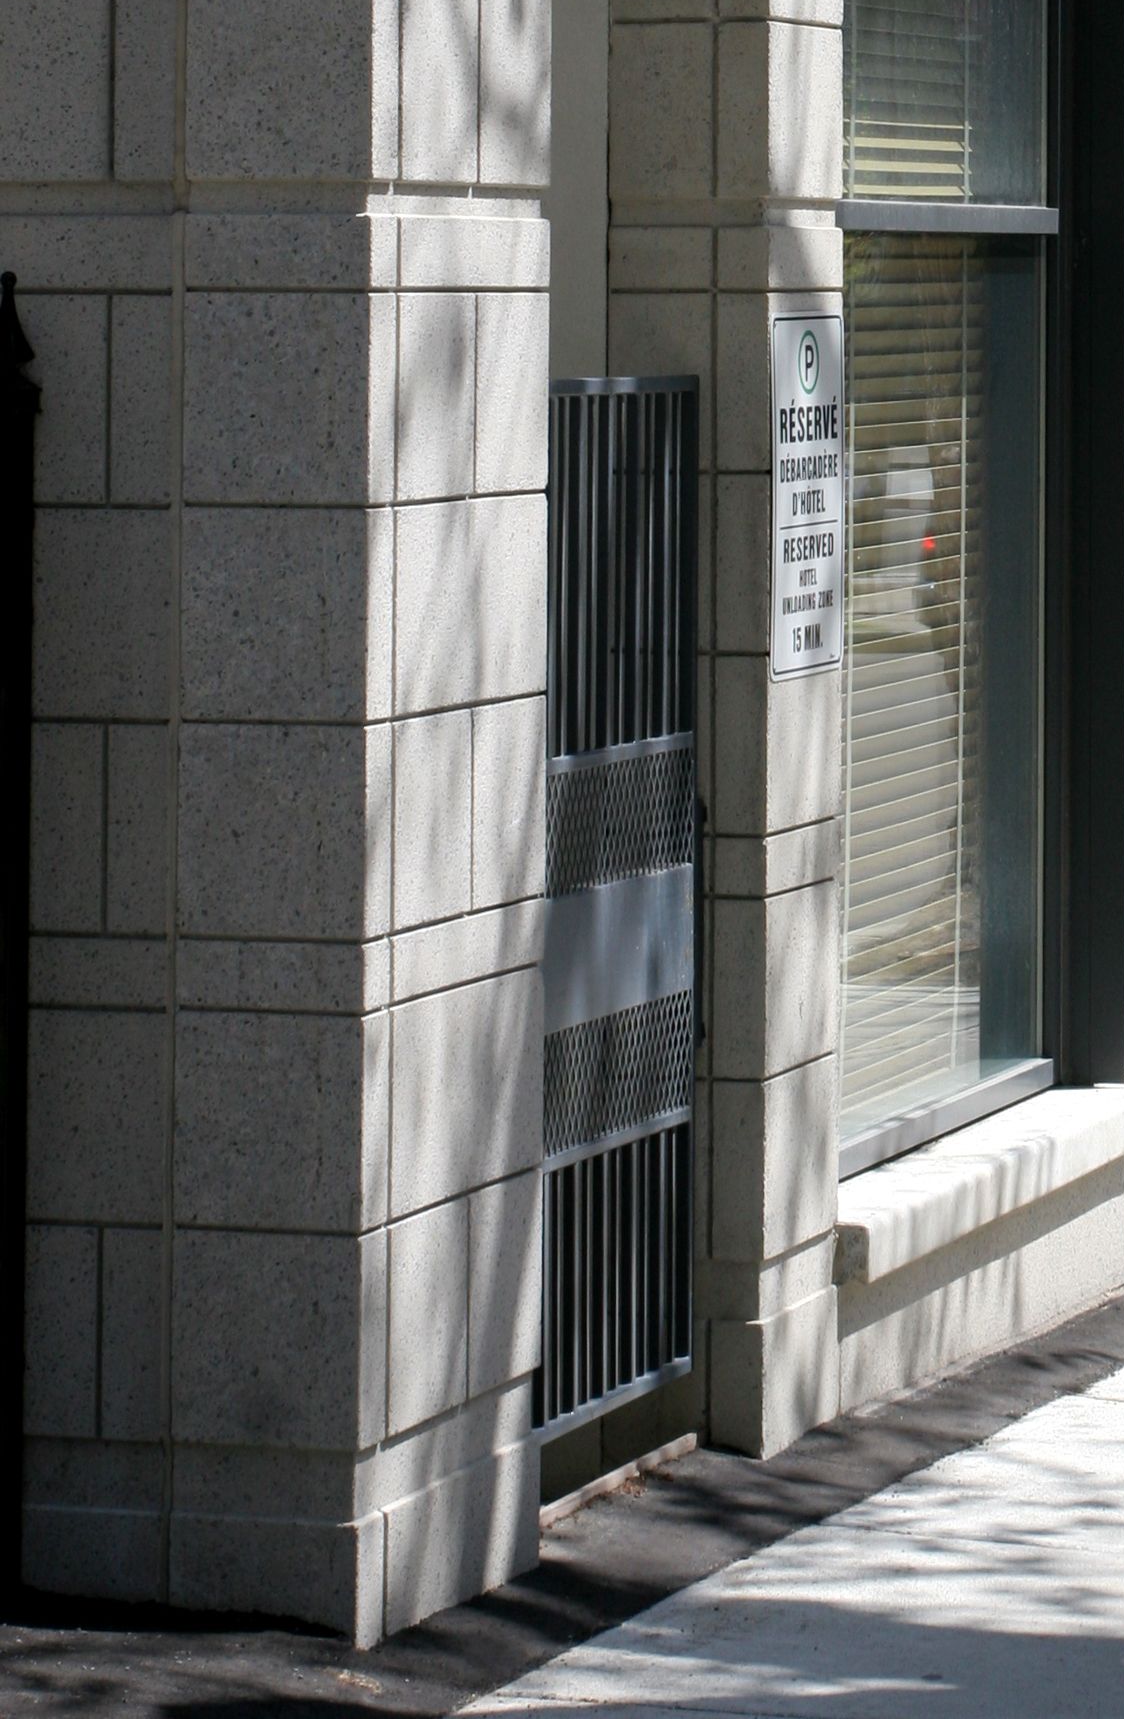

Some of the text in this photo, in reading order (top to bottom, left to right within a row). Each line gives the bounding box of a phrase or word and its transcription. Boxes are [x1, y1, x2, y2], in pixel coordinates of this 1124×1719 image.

[805, 344, 814, 382] P
[780, 398, 838, 445] RÉSERVÉ
[779, 452, 838, 484] DÉBARCADÈRE
[792, 486, 826, 517] D'HÔTEL
[783, 531, 834, 564] RESERVED
[799, 568, 818, 587] HOTEL
[782, 589, 834, 616] UNLOADING ZONE
[792, 627, 802, 653] 15
